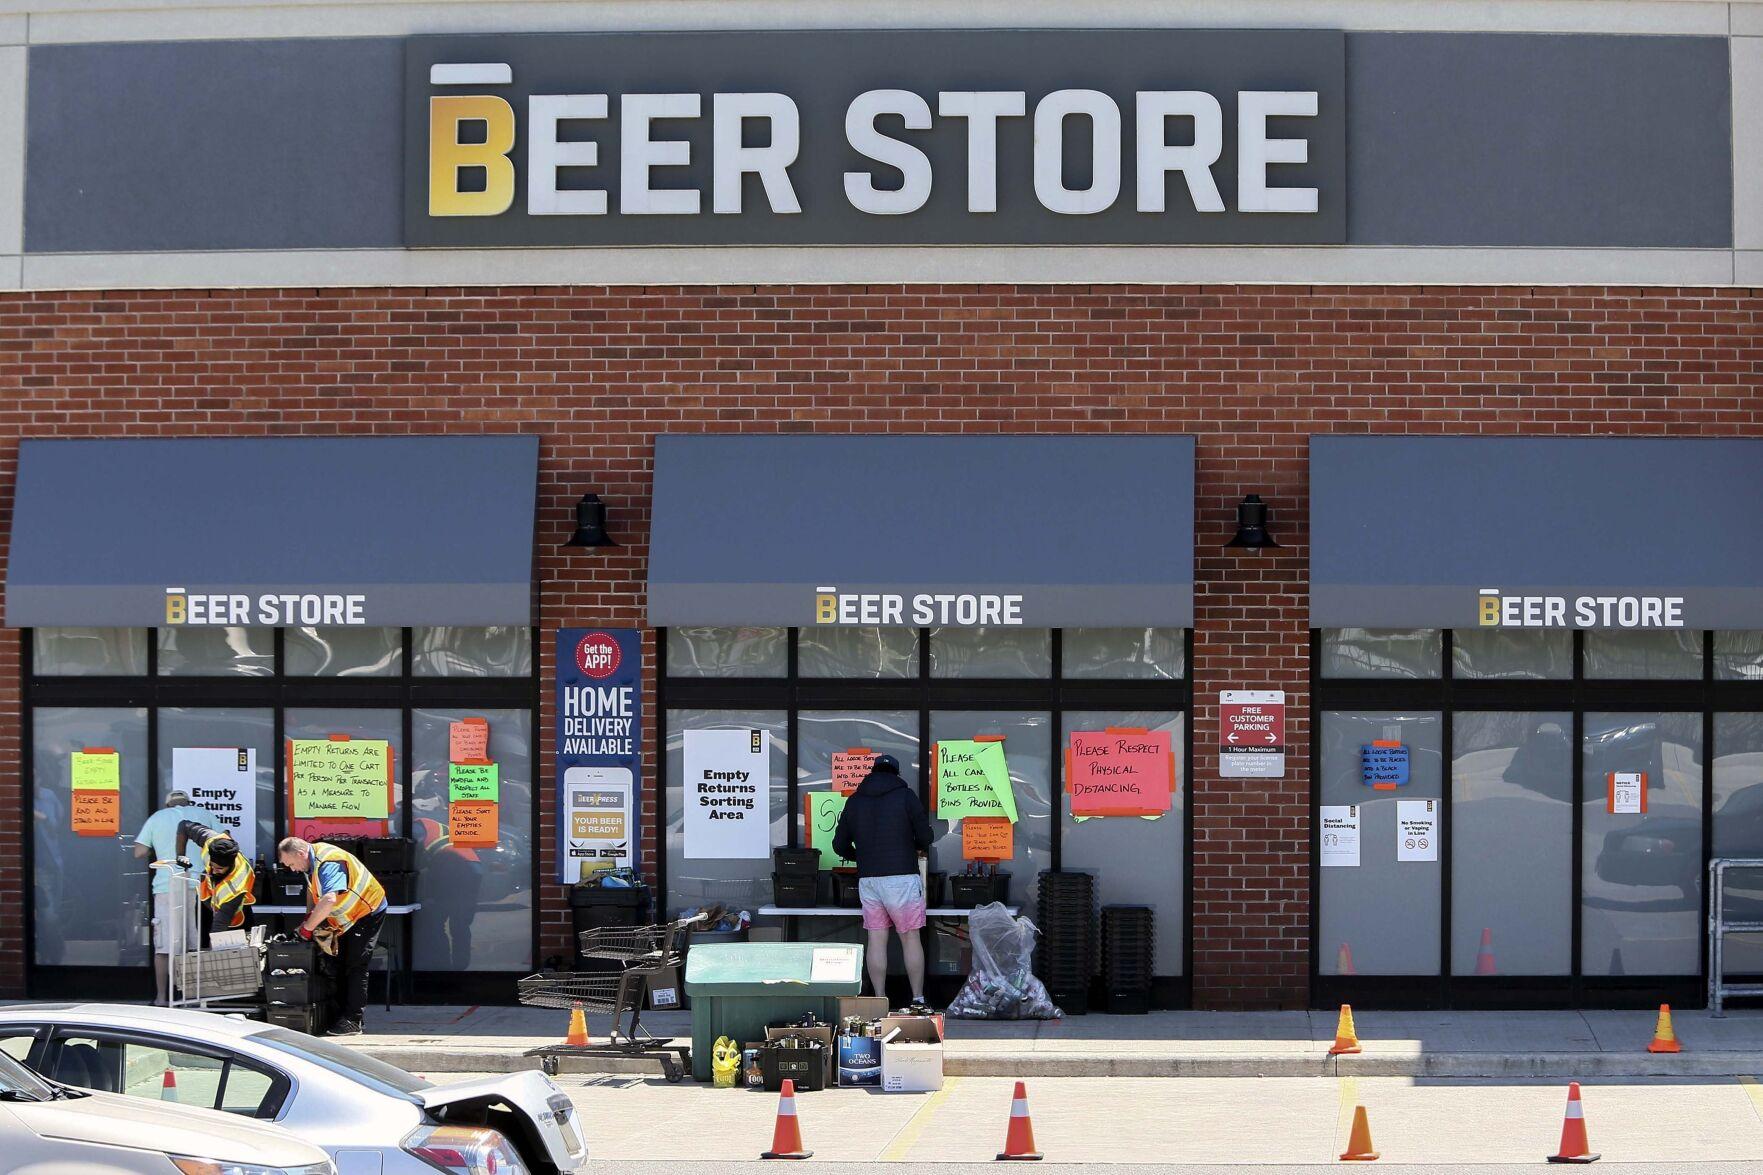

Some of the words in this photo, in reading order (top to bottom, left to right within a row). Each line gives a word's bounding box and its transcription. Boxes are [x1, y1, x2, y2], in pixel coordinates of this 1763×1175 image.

[430, 63, 802, 216] BEER
[844, 89, 1319, 215] STORE
[166, 588, 250, 624] BEER
[258, 594, 366, 625] STORE
[816, 587, 903, 624] BEER
[912, 594, 1023, 625] STORE
[1479, 589, 1566, 626] BEER
[1575, 596, 1684, 627] STORE
[584, 643, 598, 654] Get
[599, 644, 613, 654] the
[584, 655, 611, 669] APP!
[564, 686, 633, 717] HOME
[564, 718, 632, 736] DELIVERY
[1234, 723, 1270, 731] PARKING
[294, 744, 321, 756] EMPTY
[325, 744, 359, 755] RETURNS
[363, 746, 380, 756] ARE
[563, 739, 633, 755] AVAILABLE
[1073, 738, 1109, 757] PLEASE
[1115, 739, 1160, 754] RESPECT
[941, 747, 974, 764] PLEASE
[293, 760, 324, 768] LIMITED
[328, 761, 337, 769] TO
[339, 760, 355, 770] ONE
[359, 760, 380, 770] CART
[455, 766, 476, 774] PLEASE
[1089, 761, 1139, 776] PHYSICAL
[293, 772, 304, 781] PER
[308, 772, 332, 782] PERSON
[335, 775, 347, 784] PER
[350, 776, 388, 787] TRANSACTION
[703, 769, 750, 782] Empty
[943, 769, 959, 778] ALL
[297, 788, 307, 796] AS
[311, 788, 316, 796] A
[361, 789, 370, 797] TO
[697, 783, 756, 793] Returns
[945, 782, 980, 793] BOTTLES
[192, 788, 236, 800] Empty
[308, 801, 337, 810] MANAGE
[341, 801, 360, 810] FLOW
[699, 796, 755, 809] Sorting
[940, 797, 961, 808] BINS
[967, 796, 1003, 807] PROVIDE
[708, 809, 744, 820] Area
[574, 817, 598, 825] YOUR
[600, 817, 622, 825] BEER
